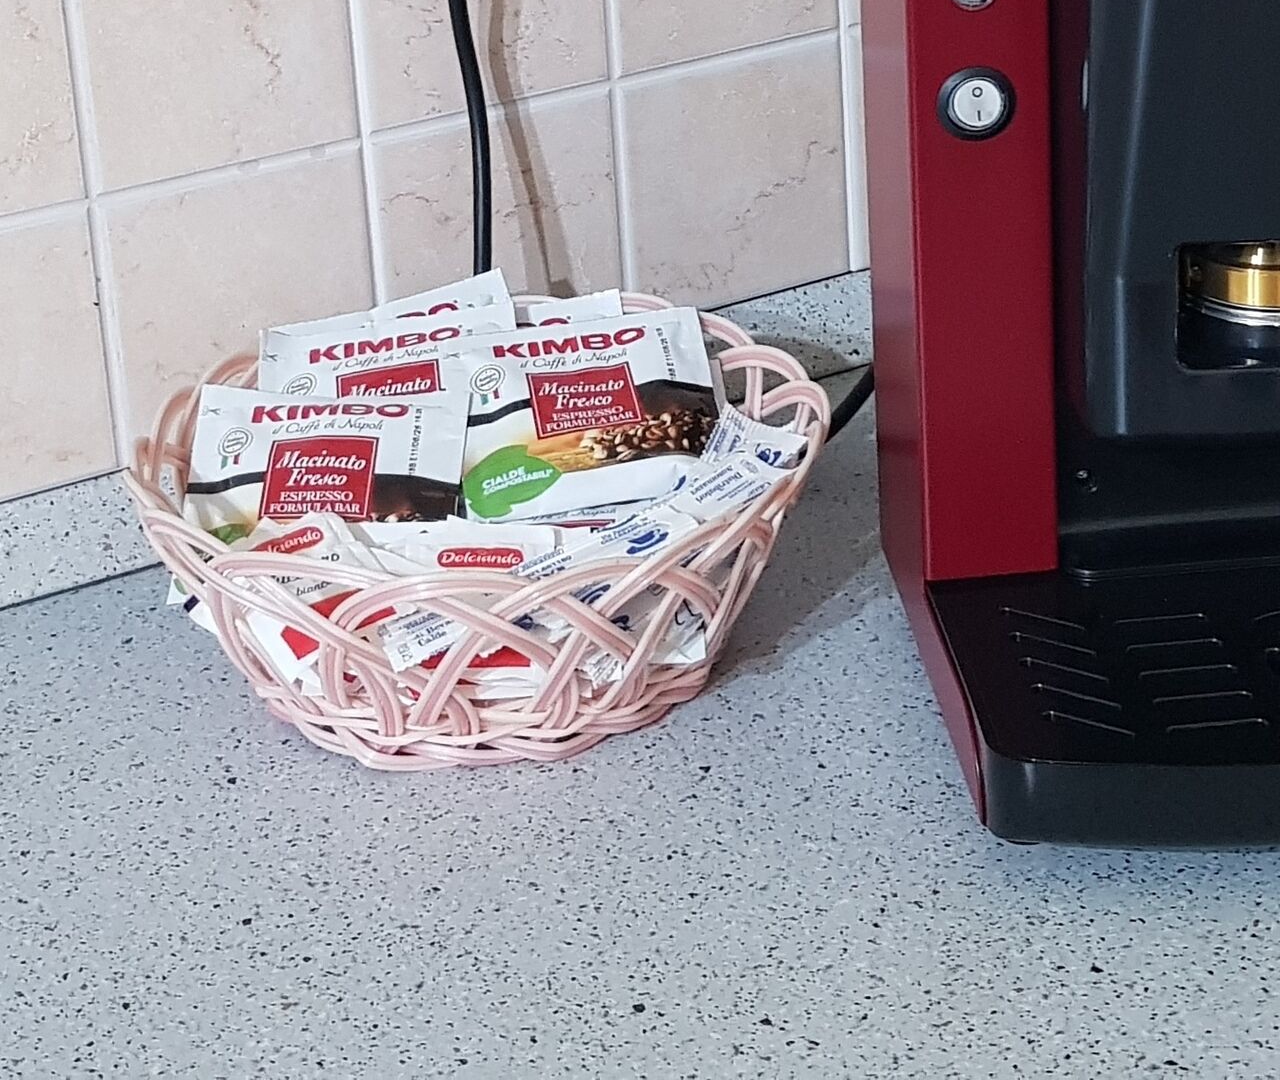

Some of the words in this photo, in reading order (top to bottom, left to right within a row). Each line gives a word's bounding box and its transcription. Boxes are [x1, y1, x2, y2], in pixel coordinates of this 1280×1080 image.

[309, 327, 460, 364] KIMBO
[493, 327, 645, 358] KIMBO
[396, 345, 439, 360] Napoli
[585, 349, 627, 365] Napoli
[349, 378, 431, 398] Macinato
[538, 378, 625, 397] Macinato
[555, 393, 612, 410] Fresco
[252, 403, 409, 423] KIMBO
[546, 415, 606, 432] FORMULA
[608, 411, 634, 423] BAR
[552, 405, 624, 421] ESPRESSO
[338, 419, 384, 433] Napoli
[275, 451, 367, 471] Macinato
[286, 468, 348, 486] Fresco
[482, 466, 525, 489] CIALDE
[280, 490, 353, 502] ESPRESSO
[269, 502, 332, 513] FORMULA
[335, 503, 360, 513] BAR
[440, 551, 522, 565] Dolciando
